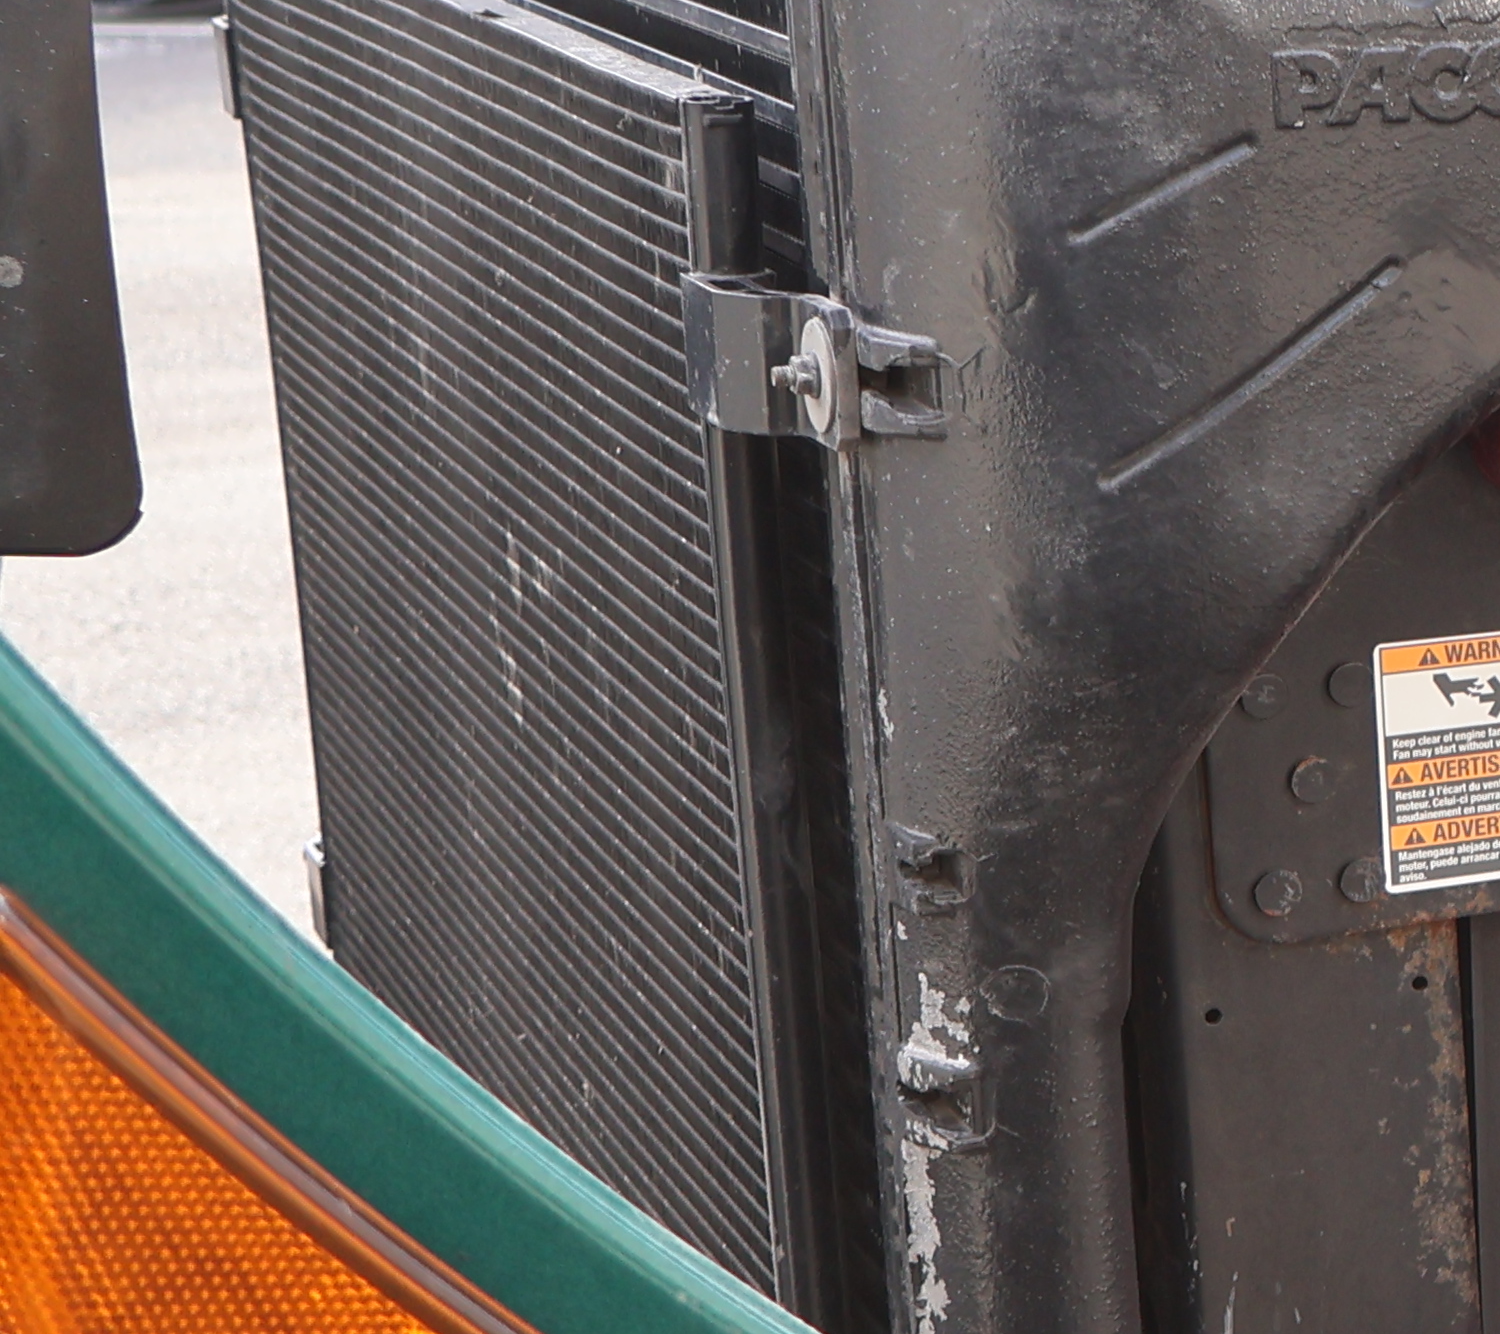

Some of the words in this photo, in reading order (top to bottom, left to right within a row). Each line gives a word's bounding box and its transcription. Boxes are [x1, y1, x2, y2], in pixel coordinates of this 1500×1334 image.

[1392, 738, 1416, 750] Keep
[1418, 734, 1441, 746] clear
[1443, 732, 1453, 743] of
[1455, 729, 1486, 744] engine
[1393, 749, 1410, 760] Fan
[1412, 748, 1433, 759] may
[1434, 744, 1457, 756] start
[1458, 740, 1494, 753] without
[1395, 789, 1427, 801] Restez
[1428, 786, 1435, 798] à
[1436, 783, 1467, 796] l'écart
[1468, 781, 1481, 792] du
[1395, 801, 1431, 813] moteur.
[1432, 795, 1468, 808] Celui-ci
[1396, 809, 1462, 824] soudainement
[1463, 805, 1476, 816] en
[1398, 847, 1456, 863] Mantengase
[1457, 841, 1491, 855] alejado
[1399, 861, 1429, 873] motor,
[1430, 857, 1459, 871] puede
[1460, 853, 1500, 865] arrancar
[1399, 872, 1427, 883] aviso.
